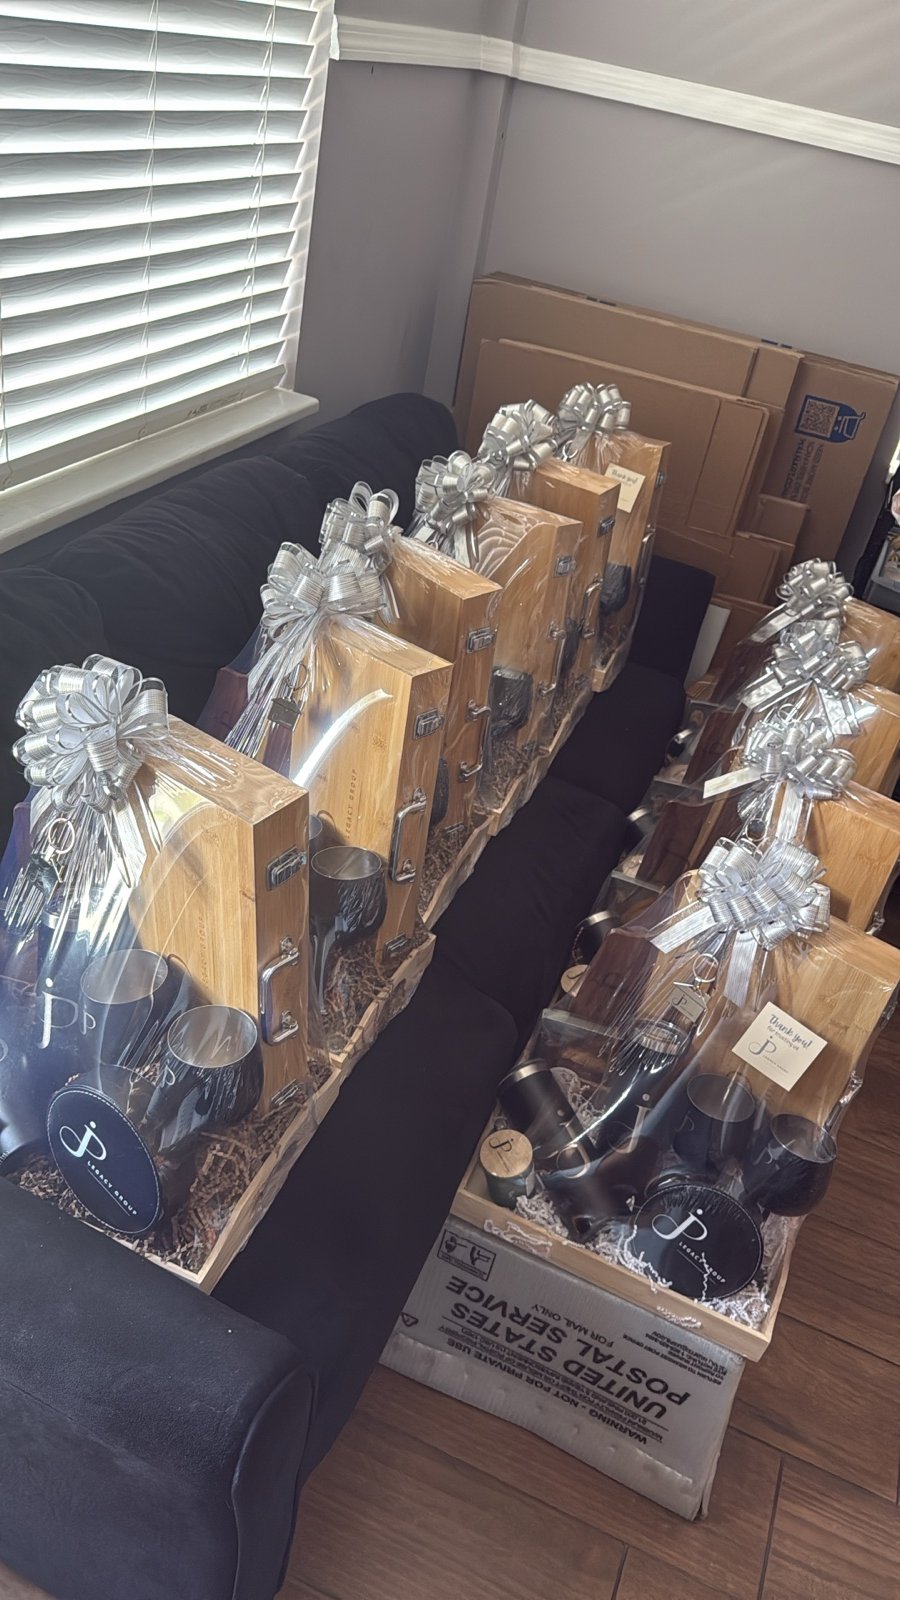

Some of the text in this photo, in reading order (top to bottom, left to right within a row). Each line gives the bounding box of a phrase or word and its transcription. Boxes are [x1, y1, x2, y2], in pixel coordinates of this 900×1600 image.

[87, 1160, 137, 1215] LEGACY GROUP
[702, 1262, 726, 1284] ROUP
[445, 1276, 567, 1344] SERVICE
[531, 1304, 614, 1348] FOR MAIL ONLY
[447, 1338, 471, 1355] USE
[451, 1302, 557, 1362] STATES
[474, 1351, 523, 1379] PRIVATE
[525, 1375, 551, 1393] FOR
[576, 1338, 691, 1406] POSTAL
[553, 1391, 579, 1408] NOT
[563, 1359, 667, 1419] UNITED
[589, 1409, 649, 1445] WARNING
